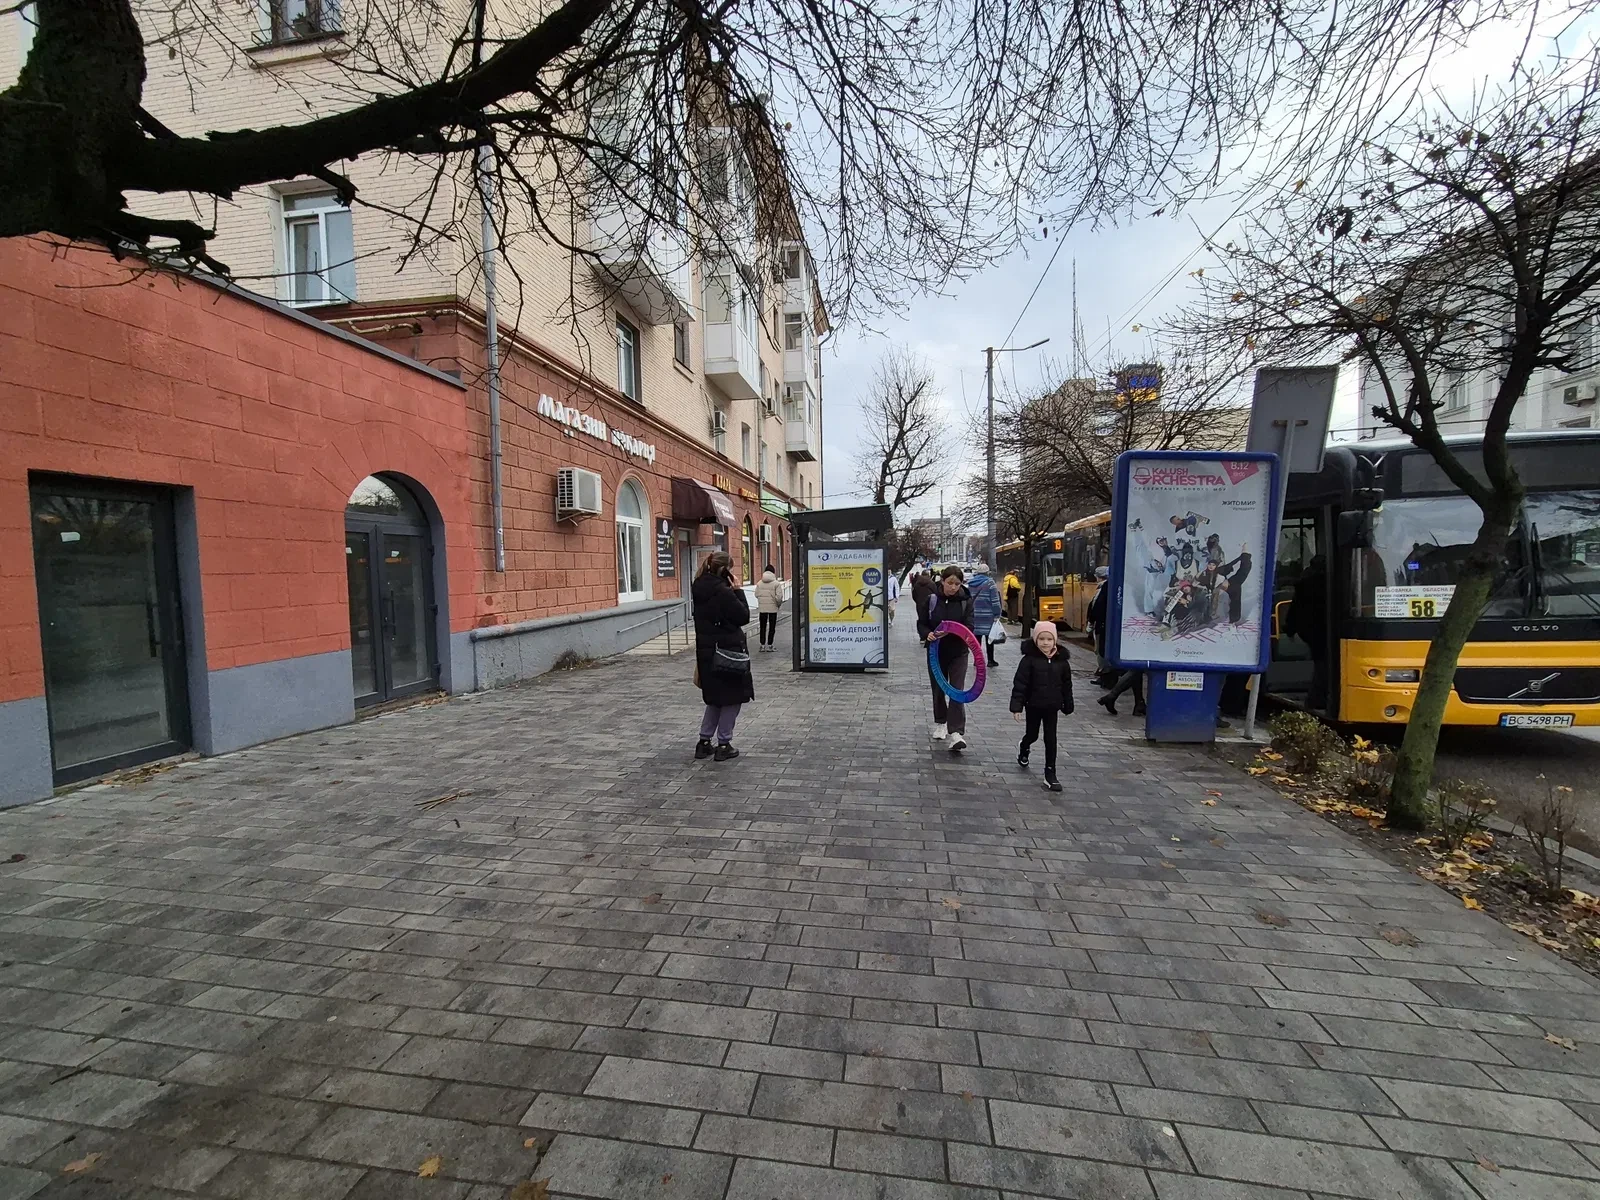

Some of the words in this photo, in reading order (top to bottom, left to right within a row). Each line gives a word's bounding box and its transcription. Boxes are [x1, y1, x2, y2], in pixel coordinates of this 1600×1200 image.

[1231, 462, 1248, 470] 8.12
[1412, 600, 1434, 617] 58
[1508, 716, 1525, 725] BC
[1527, 716, 1551, 725] 5498
[1553, 716, 1570, 725] PH
